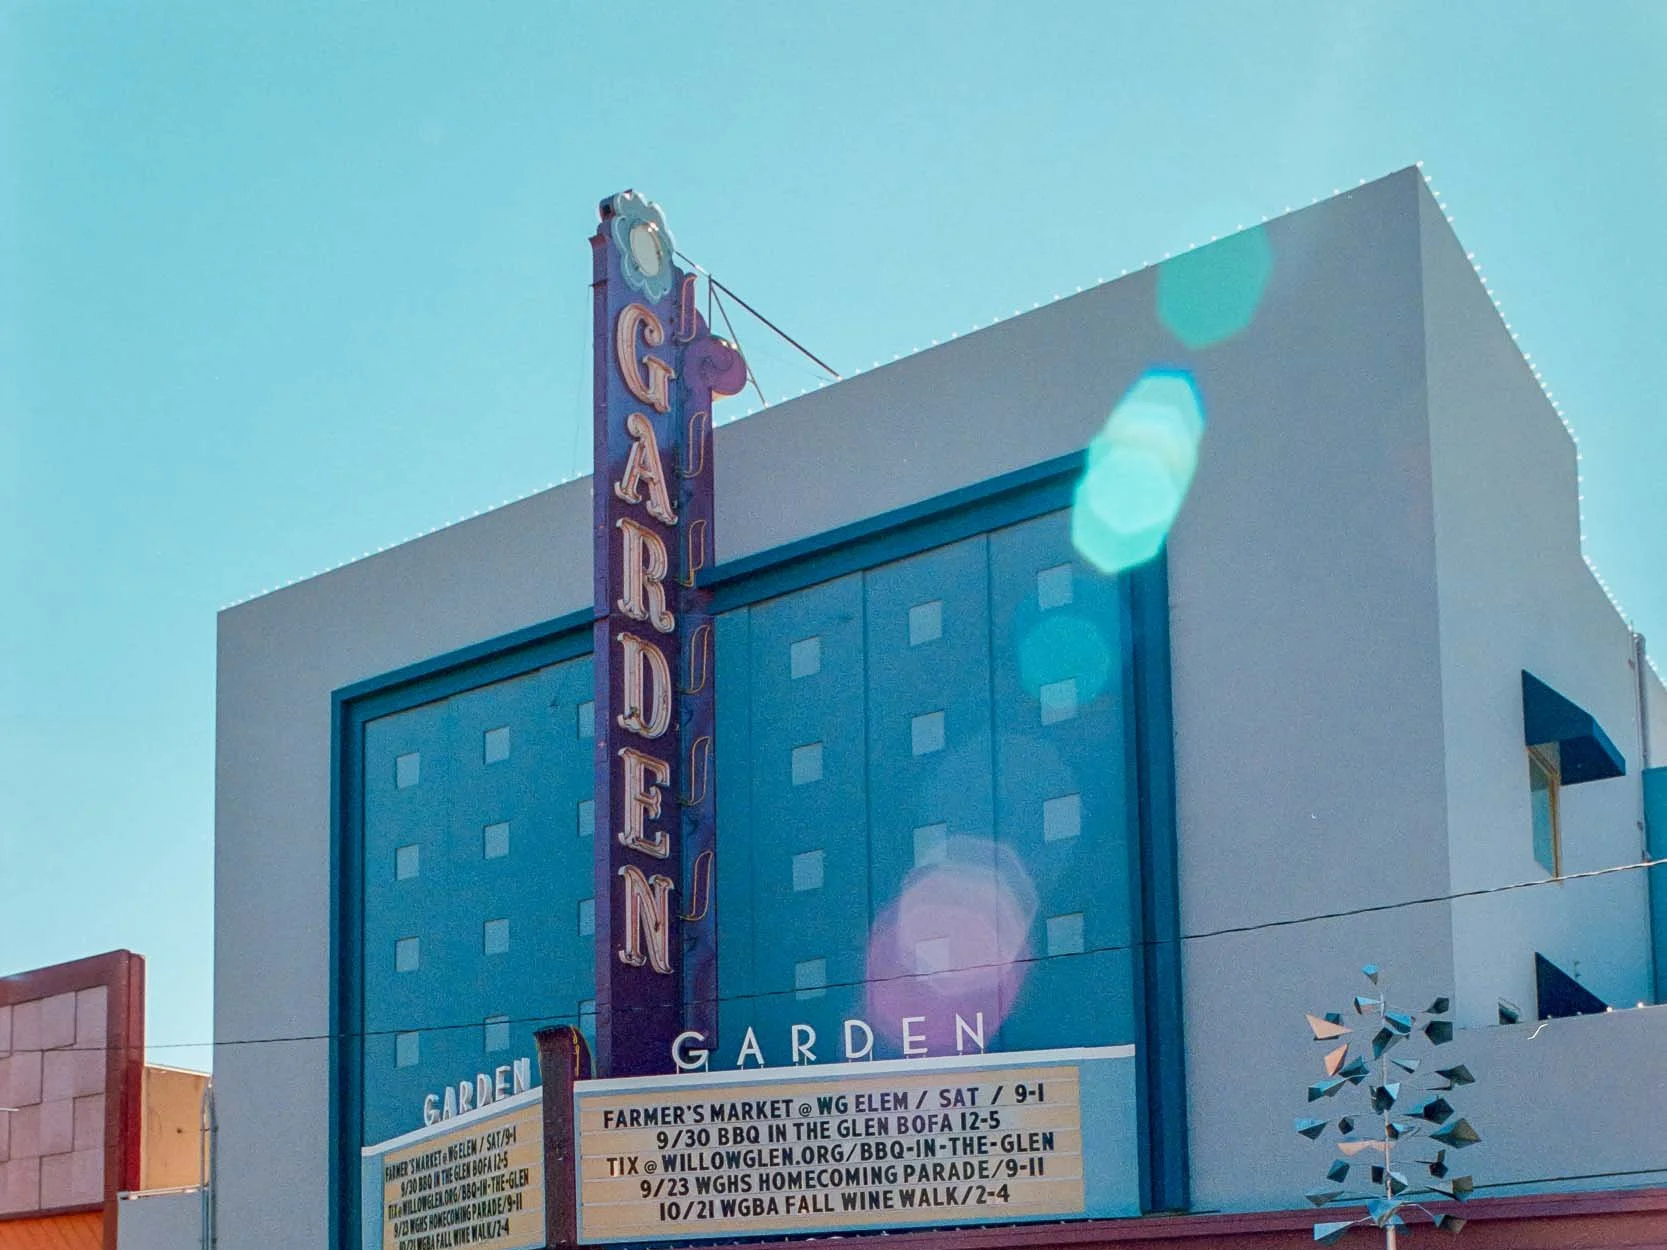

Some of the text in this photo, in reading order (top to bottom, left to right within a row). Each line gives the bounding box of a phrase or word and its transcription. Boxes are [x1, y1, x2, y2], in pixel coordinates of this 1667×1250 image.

[614, 301, 678, 977] GARDEN
[671, 1011, 985, 1071] GARDEN
[423, 1057, 531, 1127] GARDEN
[603, 1104, 705, 1129] FARMER'S
[710, 1099, 794, 1122] MARKET
[798, 1103, 812, 1117] @
[817, 1095, 848, 1115] WG
[855, 1091, 909, 1113] ELEM
[939, 1087, 979, 1108] SAT
[1014, 1083, 1044, 1104] 9-1
[458, 1136, 477, 1158] ELEM
[656, 1128, 711, 1149] 9/30
[718, 1125, 760, 1146] BBQ
[768, 1123, 787, 1143] IN
[793, 1120, 831, 1141] THE
[837, 1117, 888, 1138] GLEN
[960, 1110, 1001, 1131] 12-5
[400, 1178, 417, 1198] 9/30
[419, 1174, 433, 1192] BBQ
[434, 1171, 440, 1188] IN
[441, 1167, 453, 1186] THE
[454, 1161, 471, 1182] GLEN
[606, 1156, 640, 1176] TIX
[643, 1160, 658, 1174] @
[640, 1177, 689, 1199] 9/23
[695, 1173, 752, 1195] WGHS
[759, 1165, 898, 1192] HOMECOMING
[394, 1218, 409, 1238] 9/23
[409, 1214, 428, 1234] WGHS
[428, 1202, 472, 1228] HOMECOMING
[659, 1200, 715, 1221] 10/21
[720, 1197, 779, 1218] WGBA
[785, 1194, 835, 1214] FALL
[841, 1190, 894, 1211] WINE
[436, 1229, 452, 1249] FALL
[453, 1226, 470, 1245] WINE
